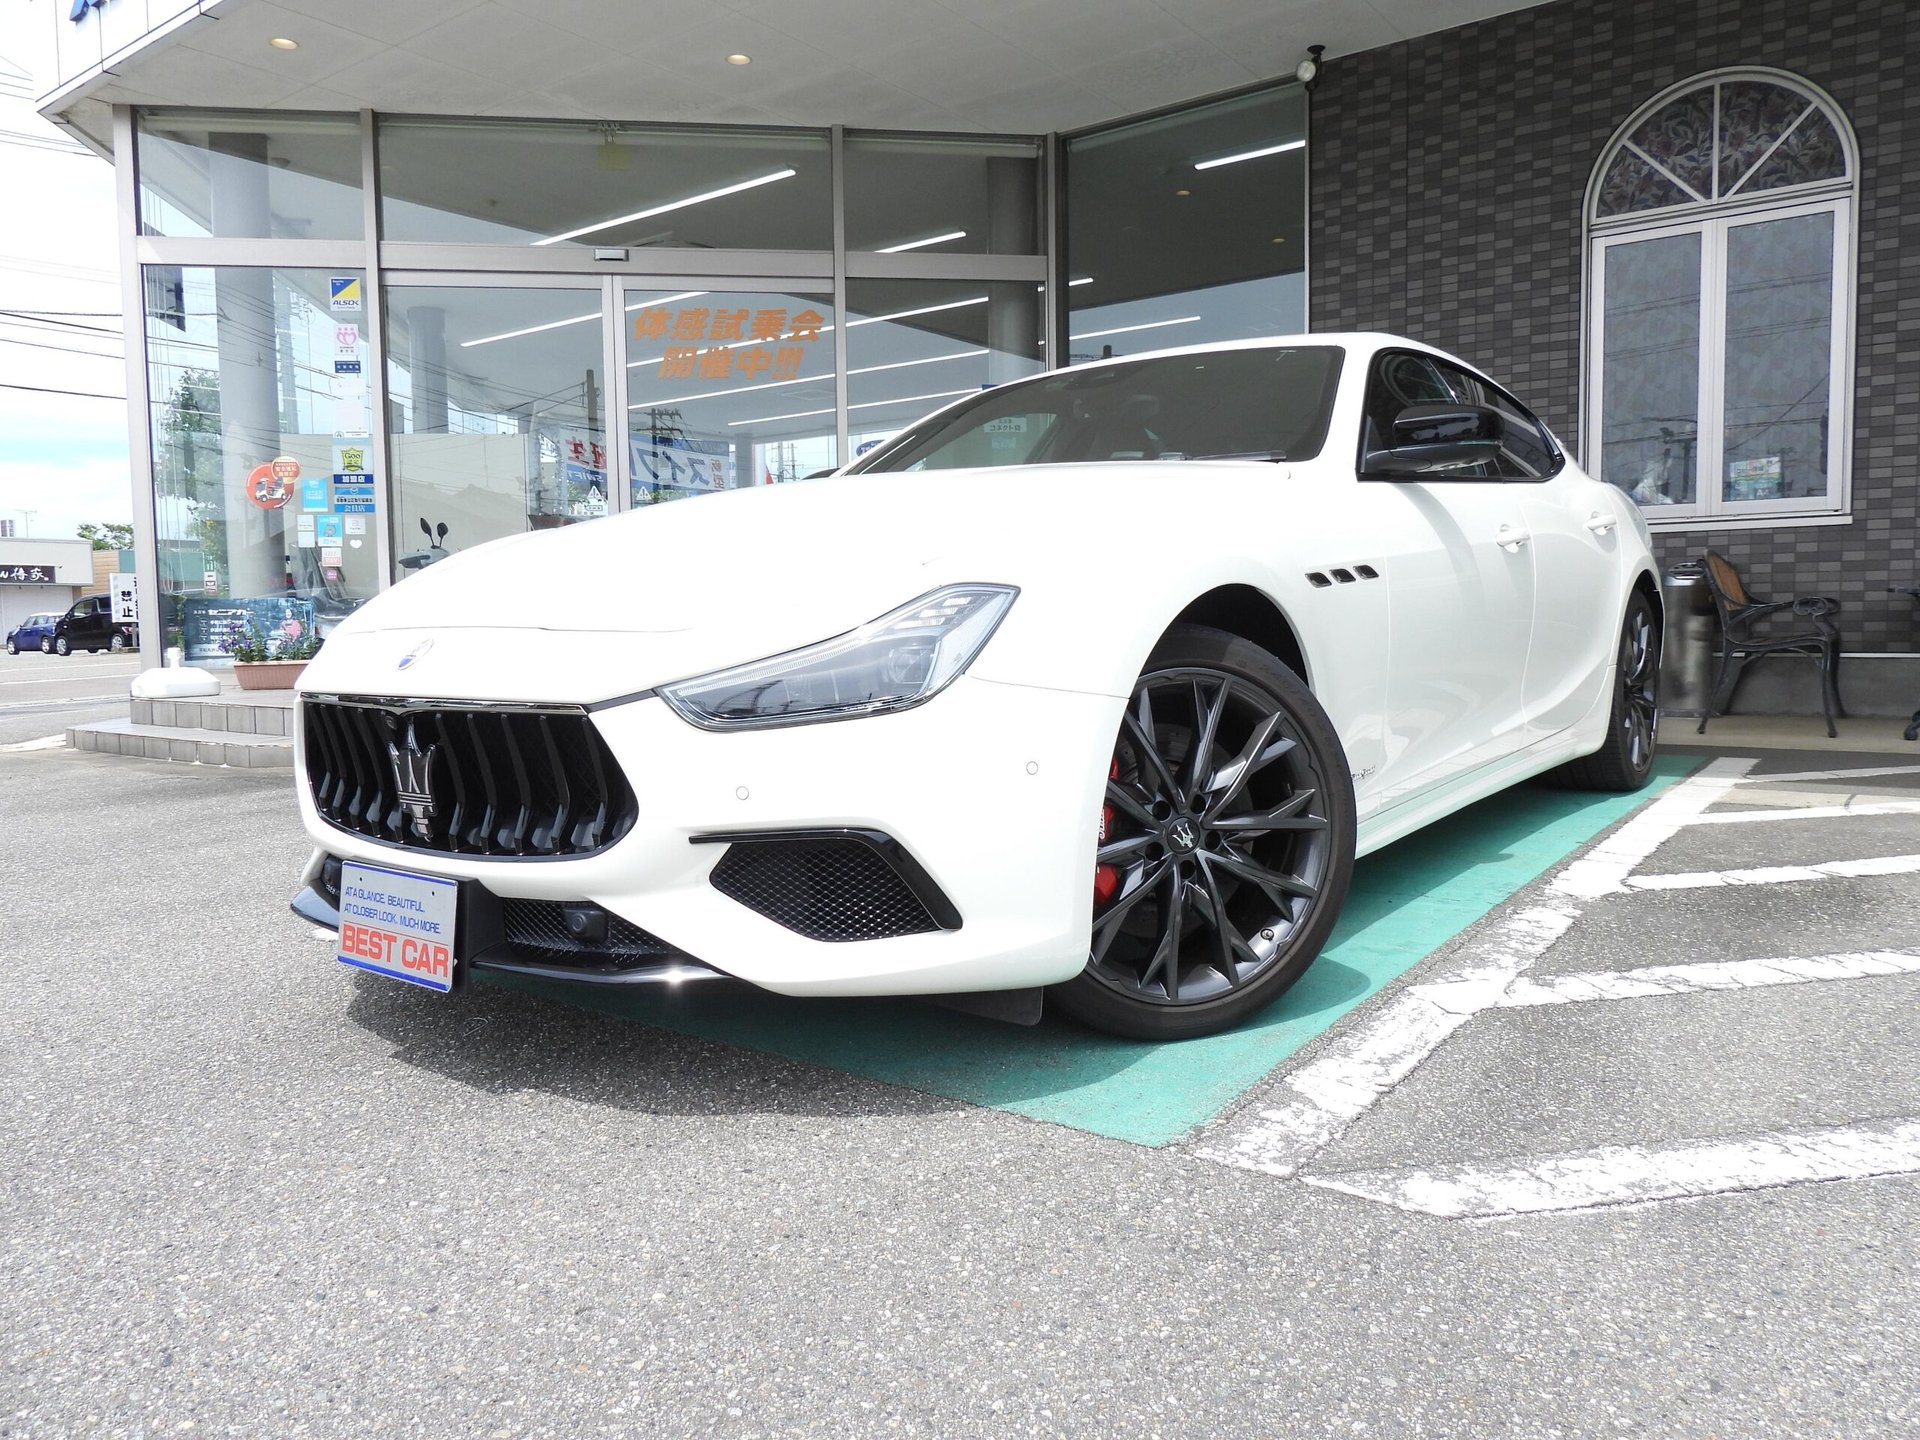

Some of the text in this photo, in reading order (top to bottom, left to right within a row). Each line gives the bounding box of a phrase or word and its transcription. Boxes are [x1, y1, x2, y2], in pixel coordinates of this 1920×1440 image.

[634, 307, 825, 343] 体感試乗会
[120, 590, 134, 618] 禁止
[345, 886, 353, 897] AT
[353, 888, 358, 898] A
[387, 895, 426, 913] BEAUTIFUL.
[344, 903, 352, 913] AT
[352, 904, 378, 919] CLOSER
[400, 915, 419, 929] MUCH
[342, 923, 449, 978] BEST CAR
